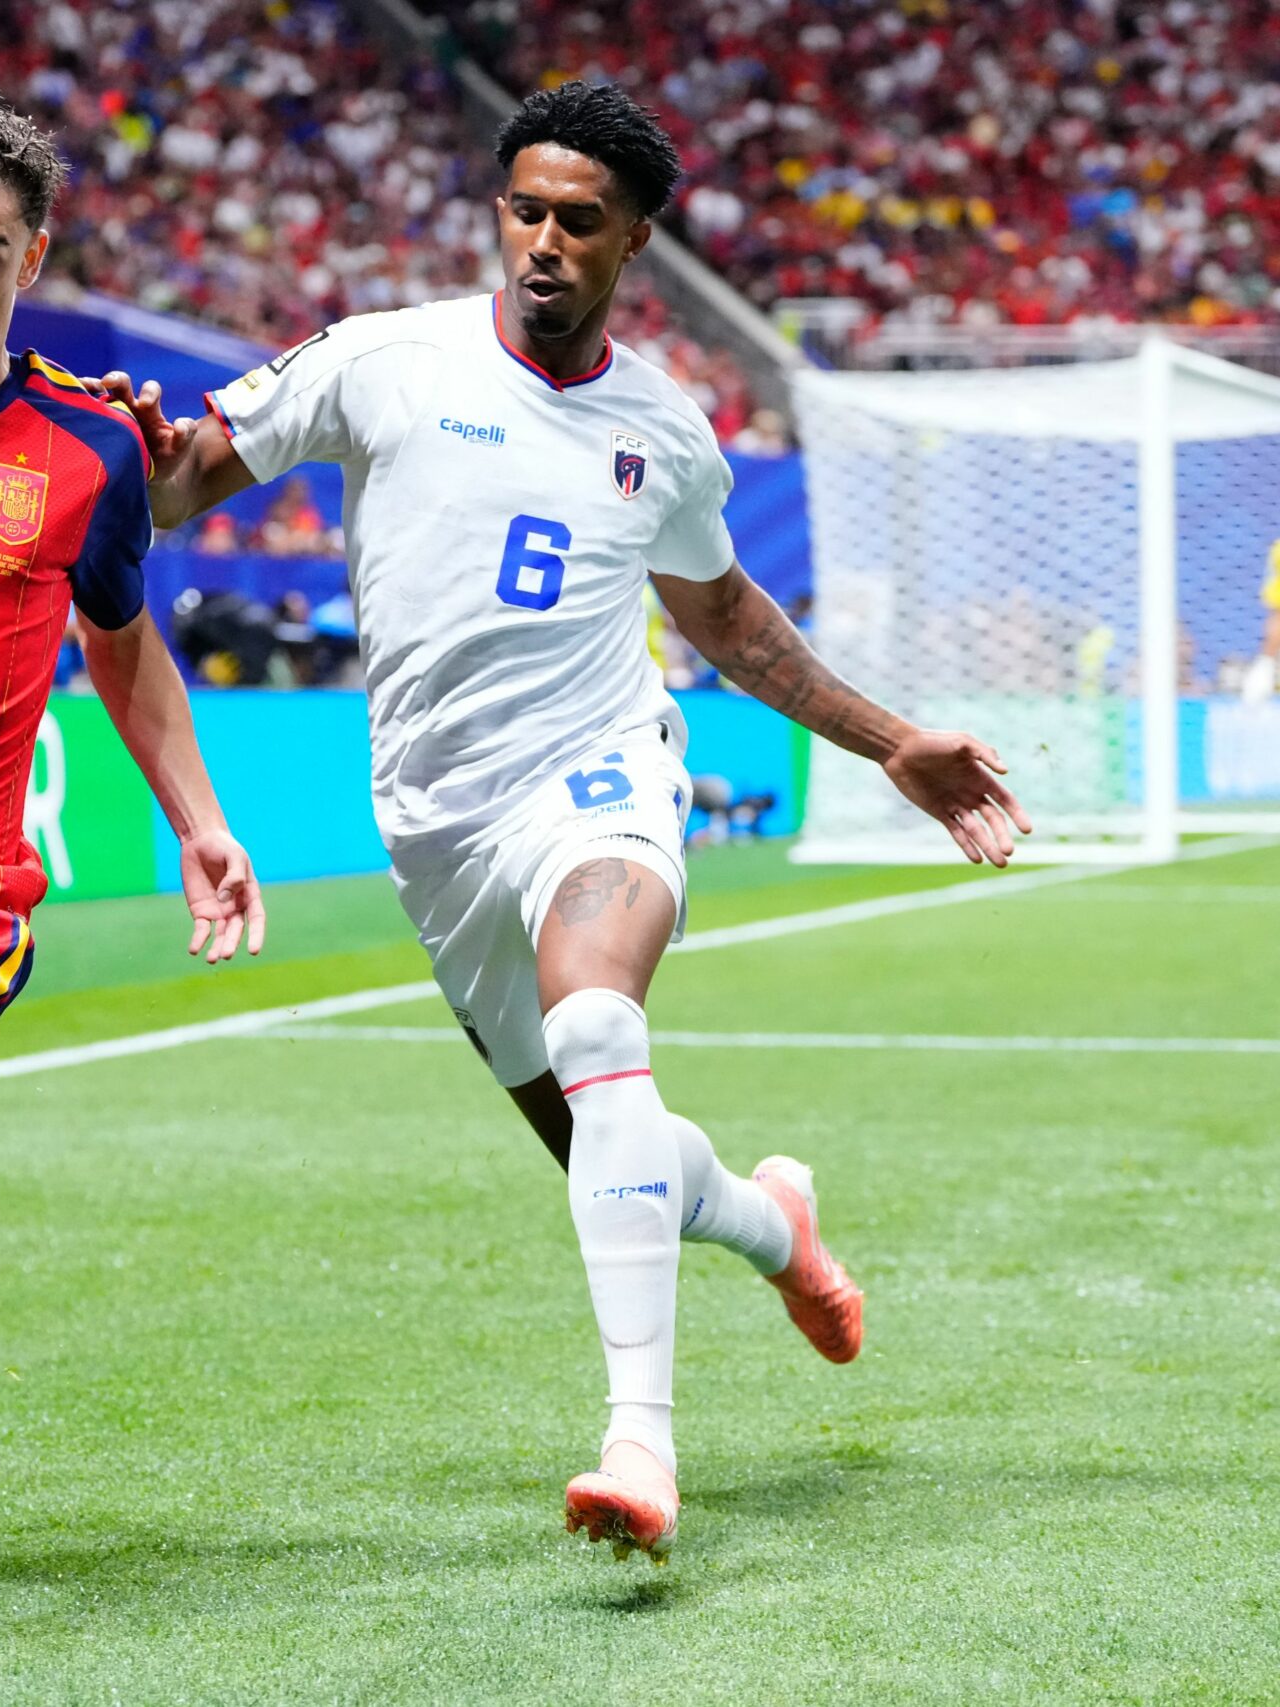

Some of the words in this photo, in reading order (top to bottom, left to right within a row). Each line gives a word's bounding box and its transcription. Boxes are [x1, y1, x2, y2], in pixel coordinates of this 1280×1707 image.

[439, 418, 506, 444] capelli
[615, 434, 647, 449] FCF
[495, 513, 572, 611] 6
[564, 751, 634, 810] 6
[593, 1181, 668, 1199] capelli
